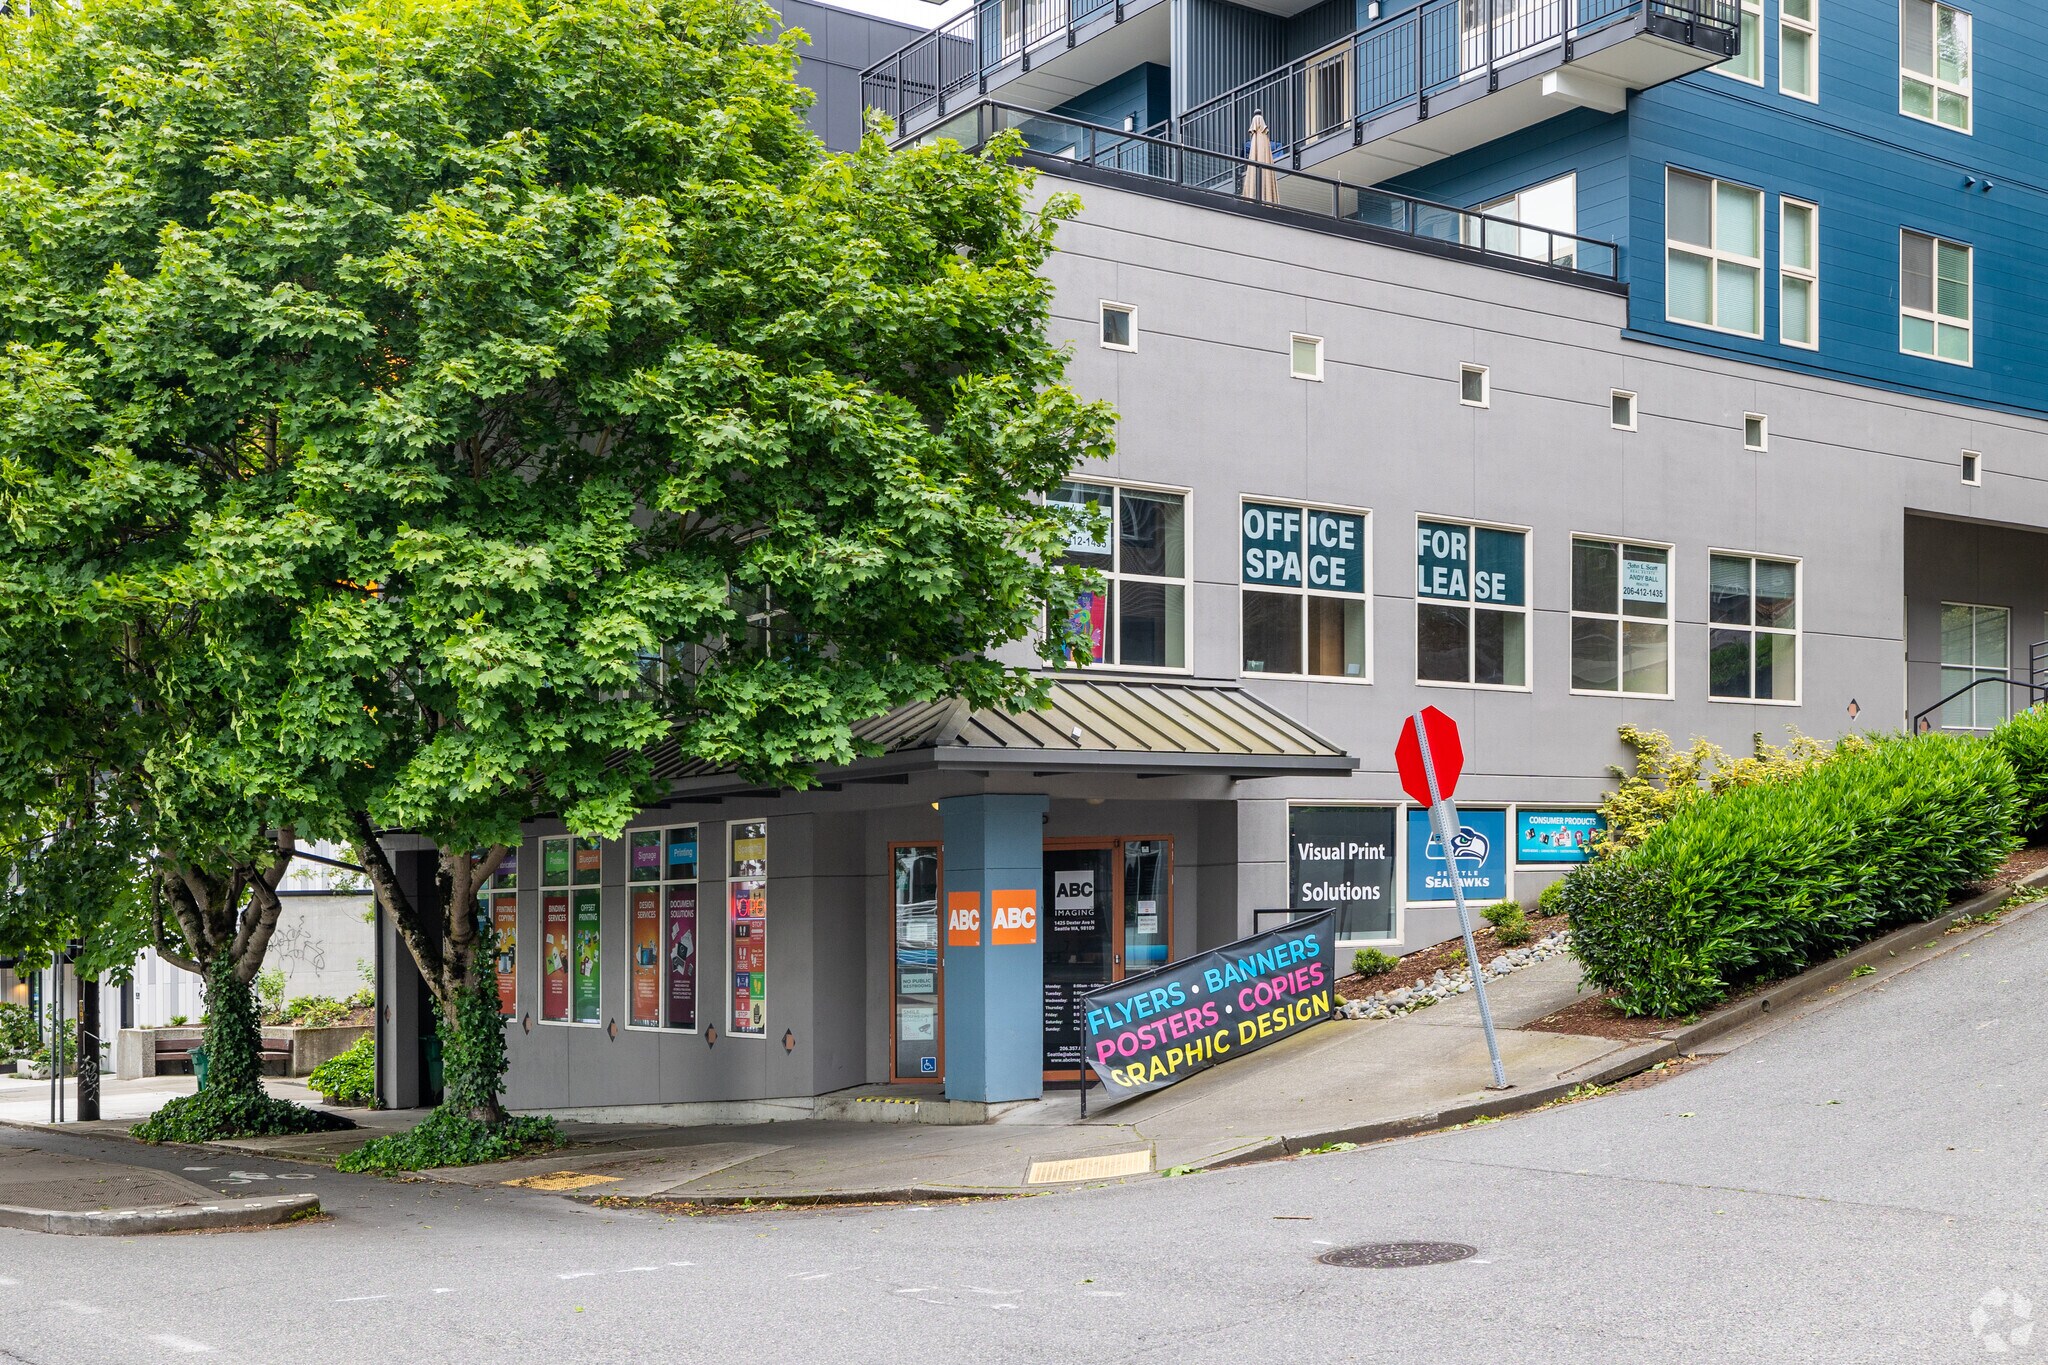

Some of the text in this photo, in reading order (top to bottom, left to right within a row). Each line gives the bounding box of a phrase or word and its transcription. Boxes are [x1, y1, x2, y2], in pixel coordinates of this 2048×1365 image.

[1243, 508, 1355, 550] OFFICE
[1418, 528, 1467, 561] FOR
[1246, 547, 1346, 587] SPACE
[1418, 564, 1506, 601] LEASE
[1623, 587, 1663, 598] 206-412-1435
[1529, 816, 1597, 826] CONSUMER PRODUCTS
[638, 851, 657, 861] Signage
[673, 847, 693, 858] Printing
[1298, 842, 1385, 861] Visual Print
[579, 855, 599, 865] Blueprint
[1425, 876, 1490, 888] SEAAWKS
[1056, 882, 1093, 897] ABC
[1302, 881, 1380, 902] Solutions
[548, 904, 566, 913] BINDING
[580, 903, 597, 912] OFFSET
[639, 901, 655, 909] DESIGN
[669, 899, 695, 908] DOCUMENT
[498, 914, 515, 922] COPYING
[547, 913, 567, 922] SERVICES
[578, 912, 598, 921] PRINTING
[637, 910, 656, 919] SERVICES
[670, 909, 695, 918] SOLUTIONS
[992, 907, 1036, 930] ABC
[949, 908, 980, 931] ABC
[1087, 934, 1321, 1035] FLYERS BANNERS
[1096, 962, 1325, 1065] POSTERS COPIES
[1111, 990, 1330, 1087] GRAPHIC DESIGN
